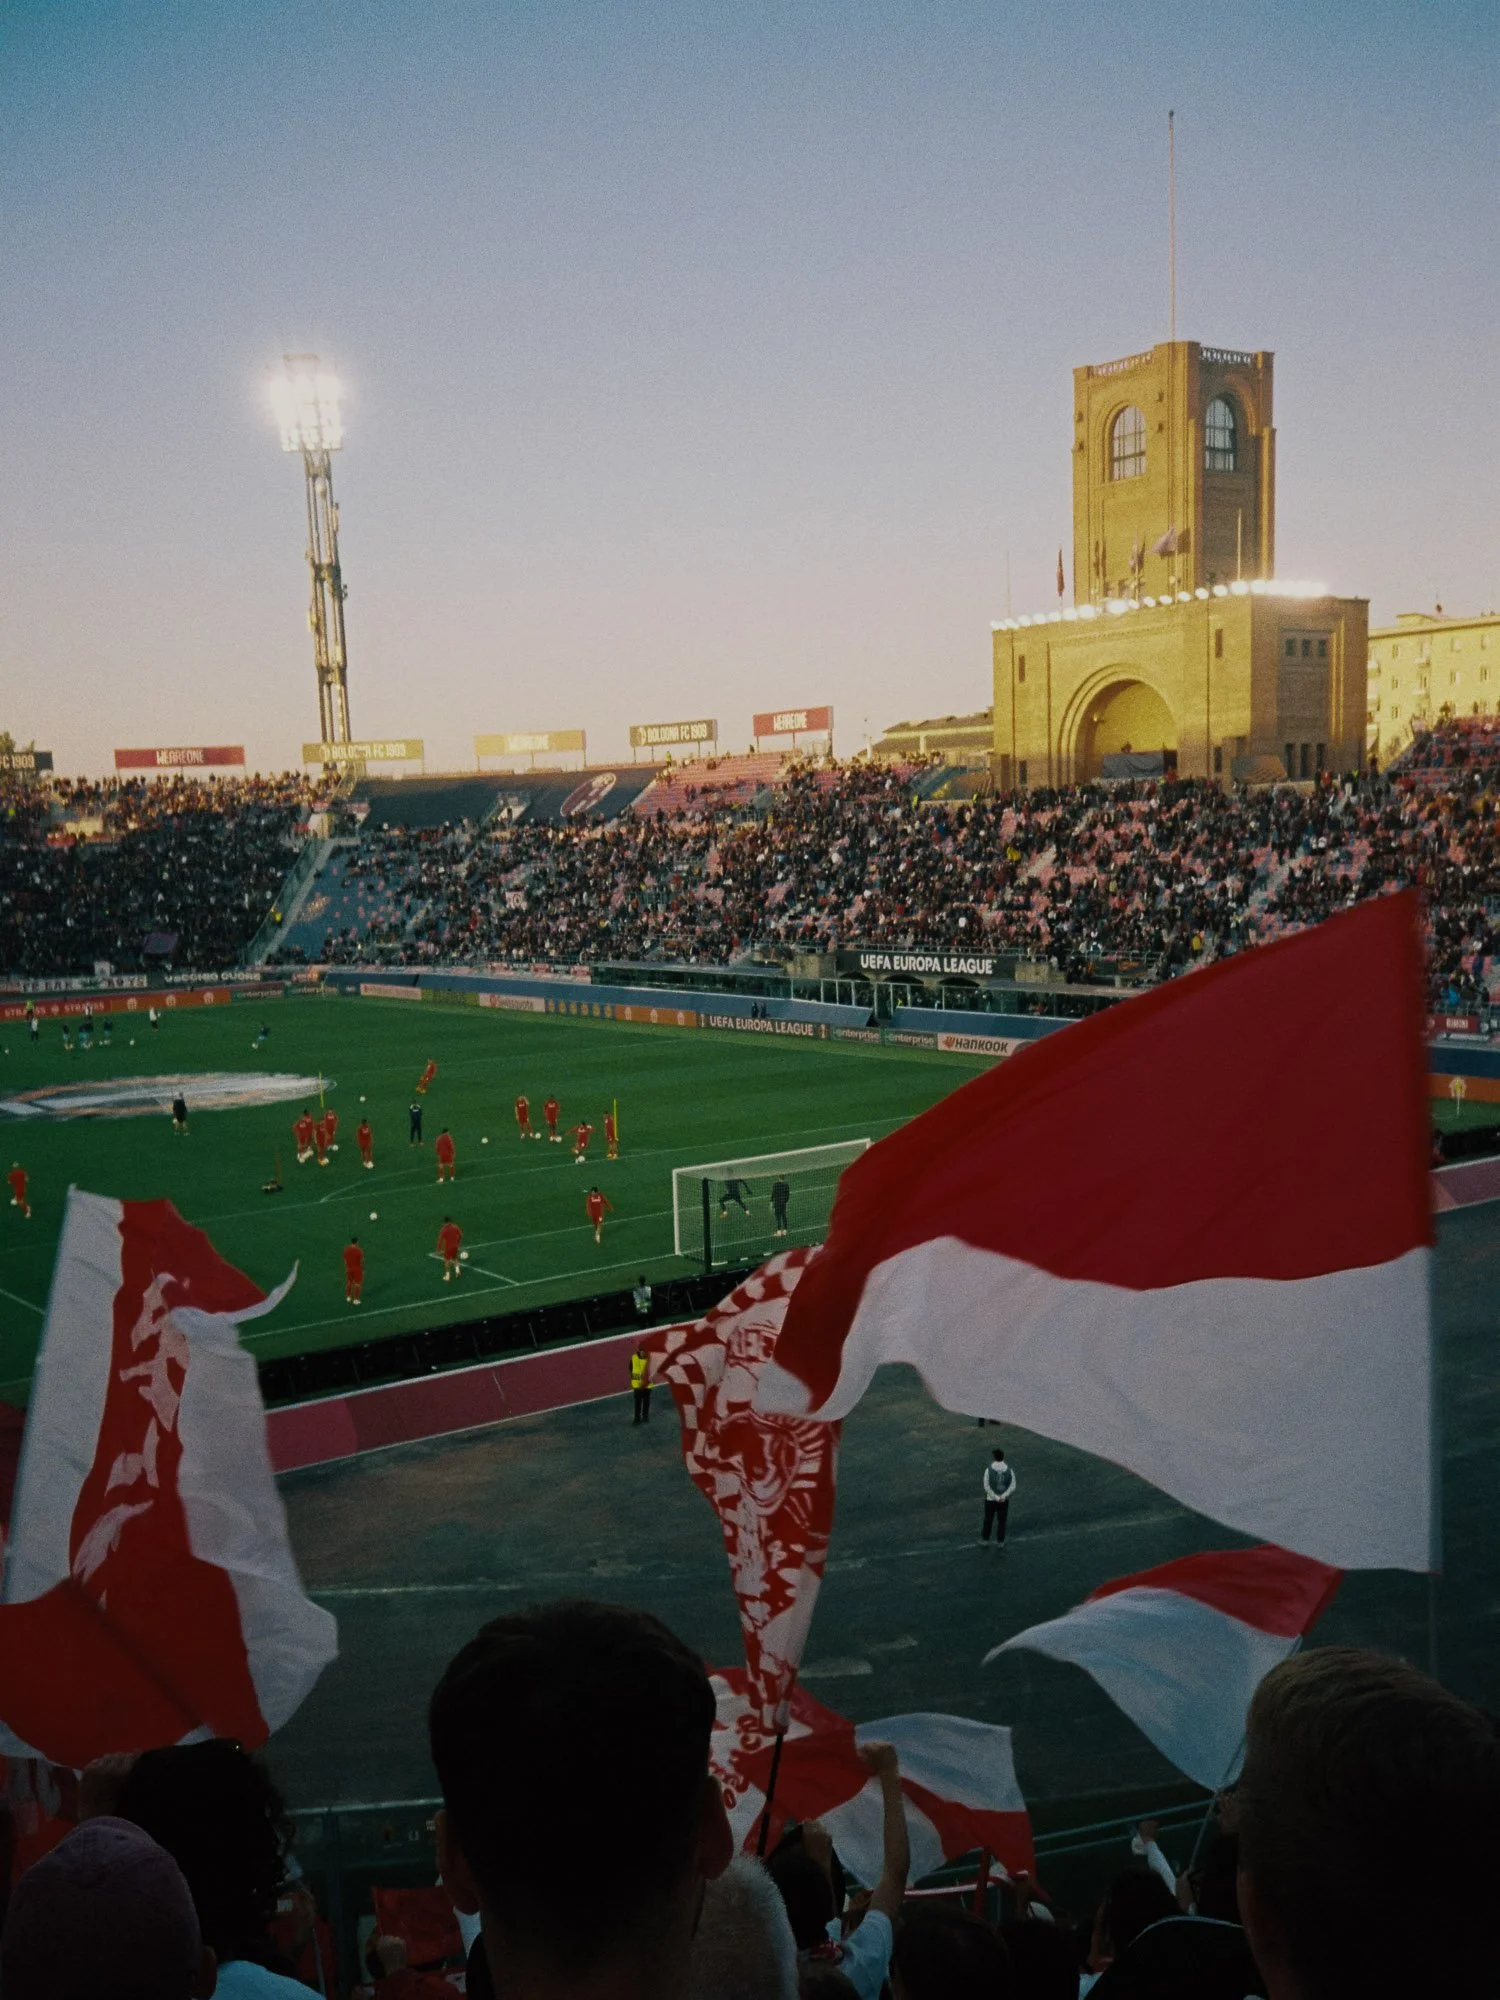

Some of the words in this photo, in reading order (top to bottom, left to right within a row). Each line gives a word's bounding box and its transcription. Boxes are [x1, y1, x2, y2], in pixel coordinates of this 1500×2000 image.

[11, 754, 35, 769] 1909
[861, 954, 891, 970] UEFA
[893, 956, 941, 972] EUROPA
[944, 957, 993, 975] LEAGUE
[709, 1015, 735, 1029] UEFA
[735, 1018, 774, 1033] EUROPA
[775, 1021, 814, 1036] LEAGUE
